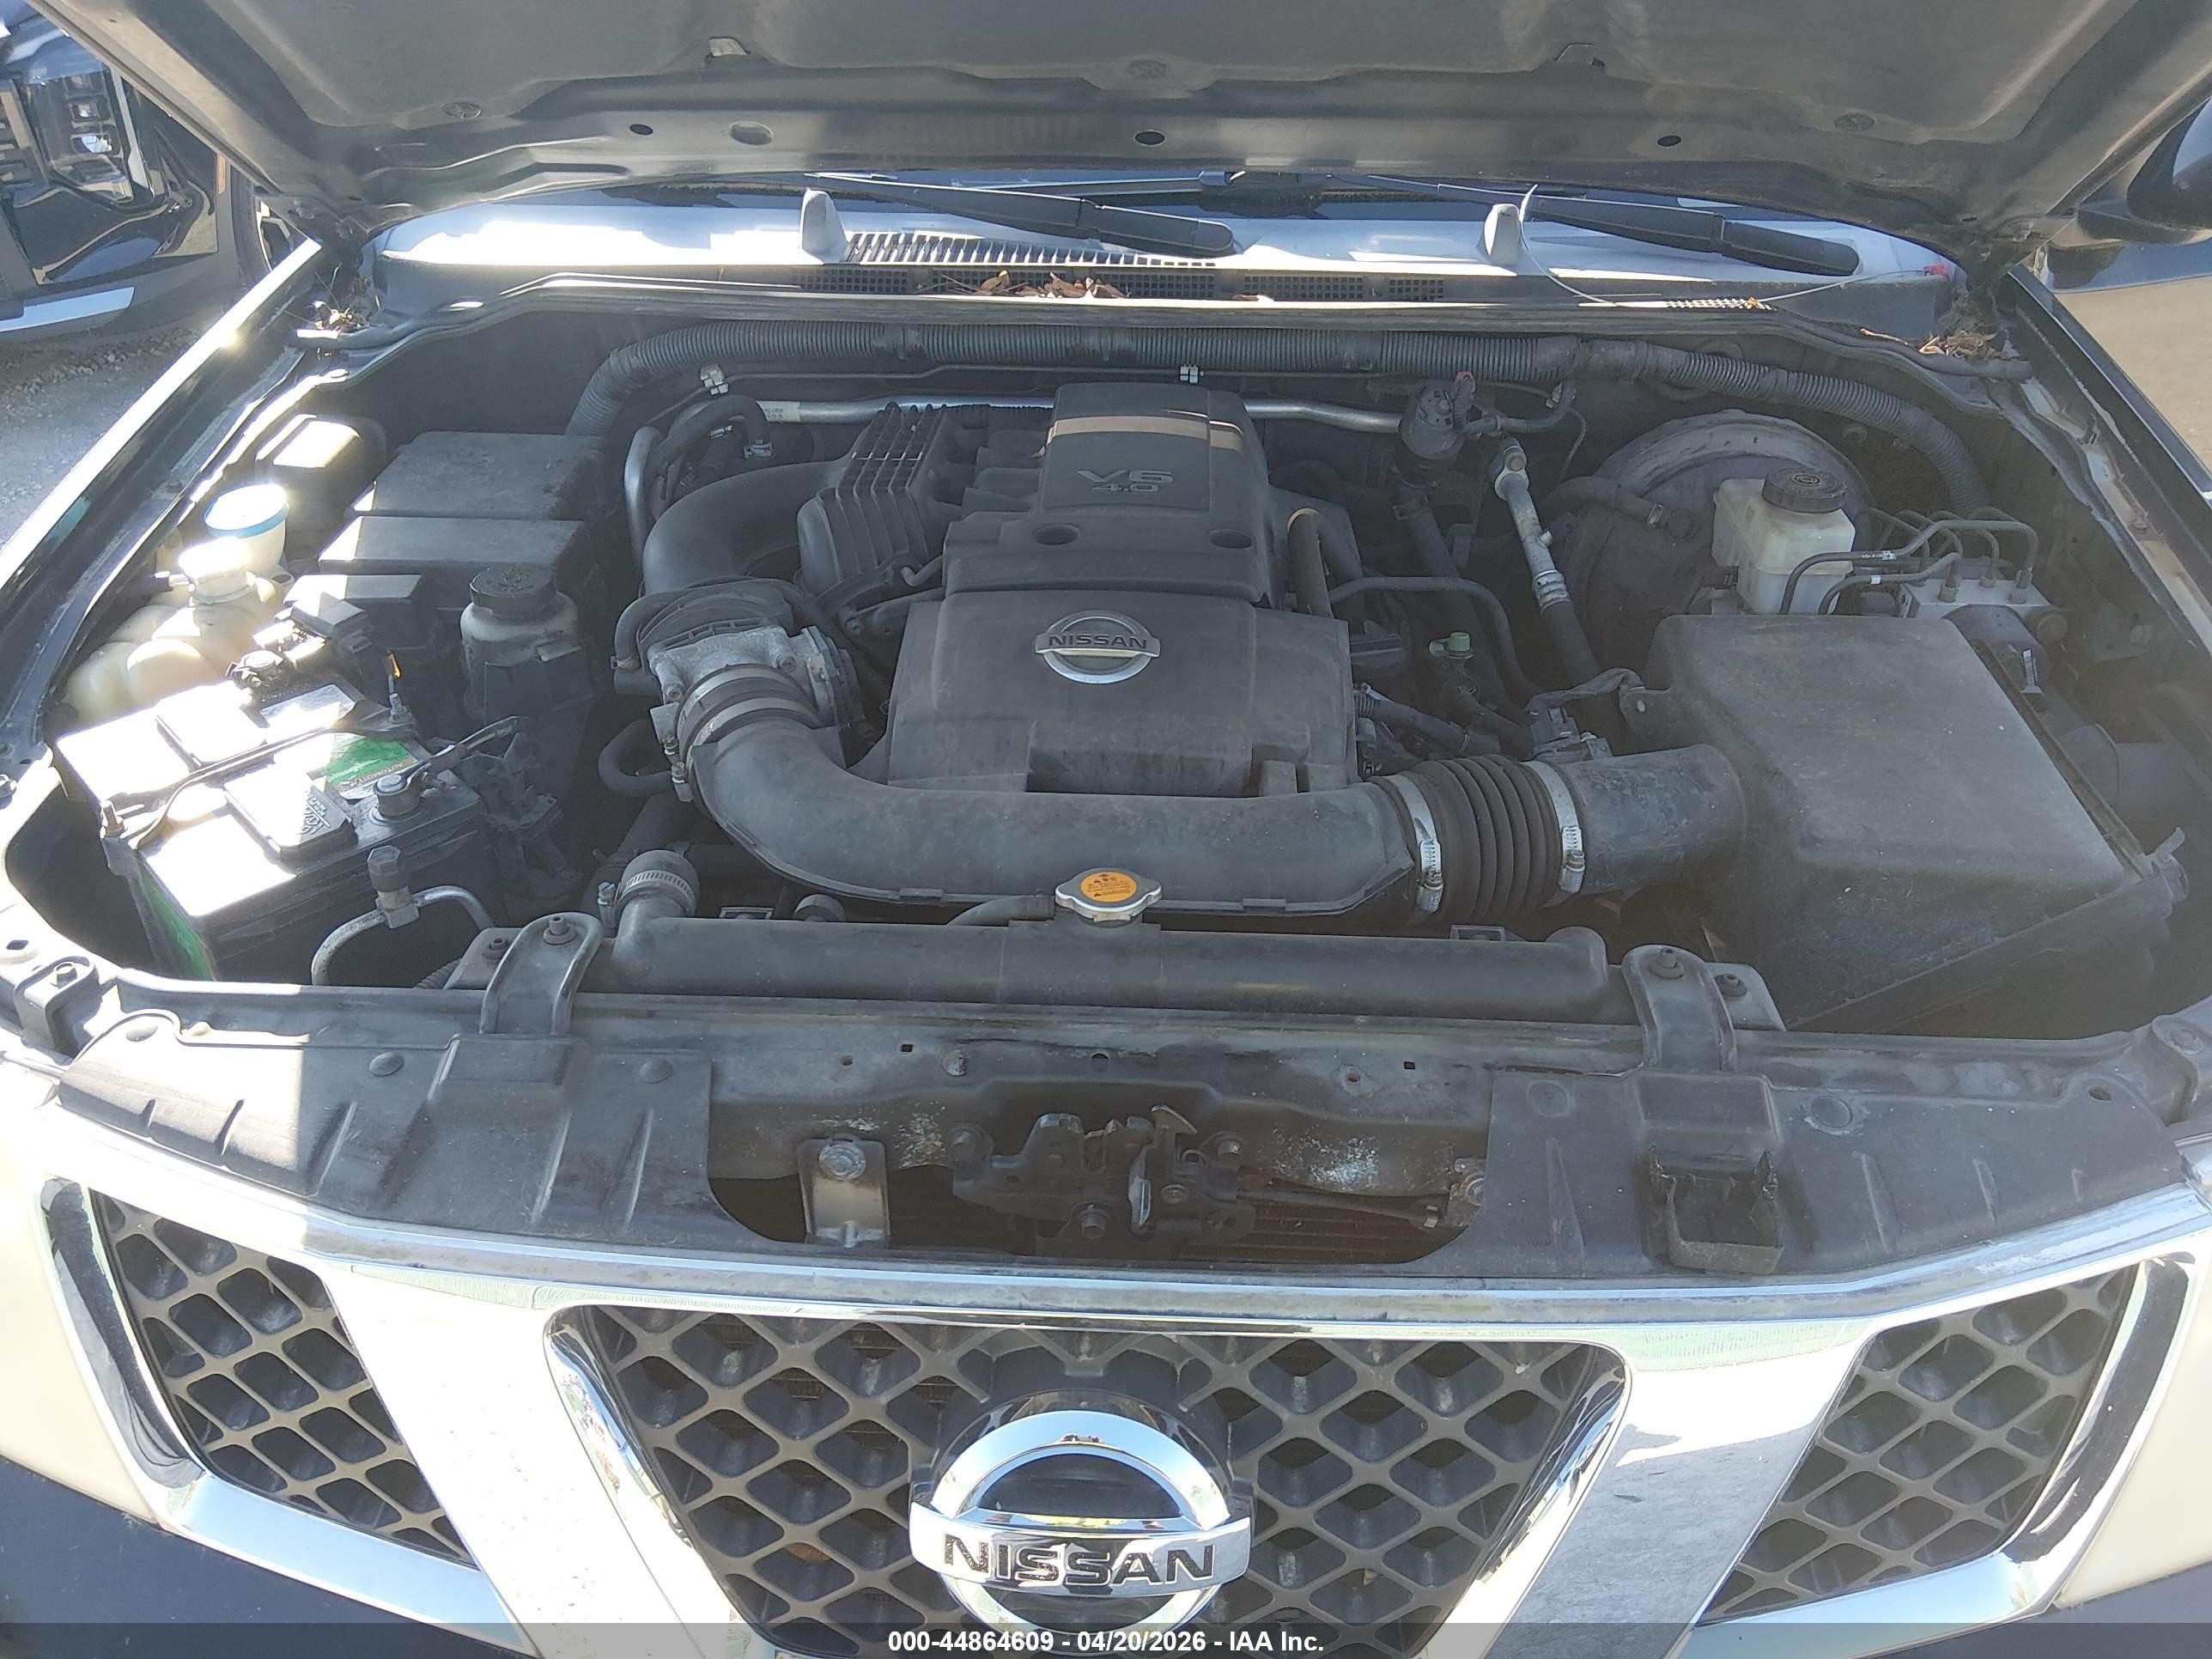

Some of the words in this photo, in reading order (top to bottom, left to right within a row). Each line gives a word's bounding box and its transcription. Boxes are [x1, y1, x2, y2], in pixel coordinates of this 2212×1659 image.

[1077, 469, 1175, 484] V6
[1091, 482, 1160, 492] 4.0
[1048, 634, 1147, 649] NISSAN
[945, 1532, 1216, 1587] NISSAN
